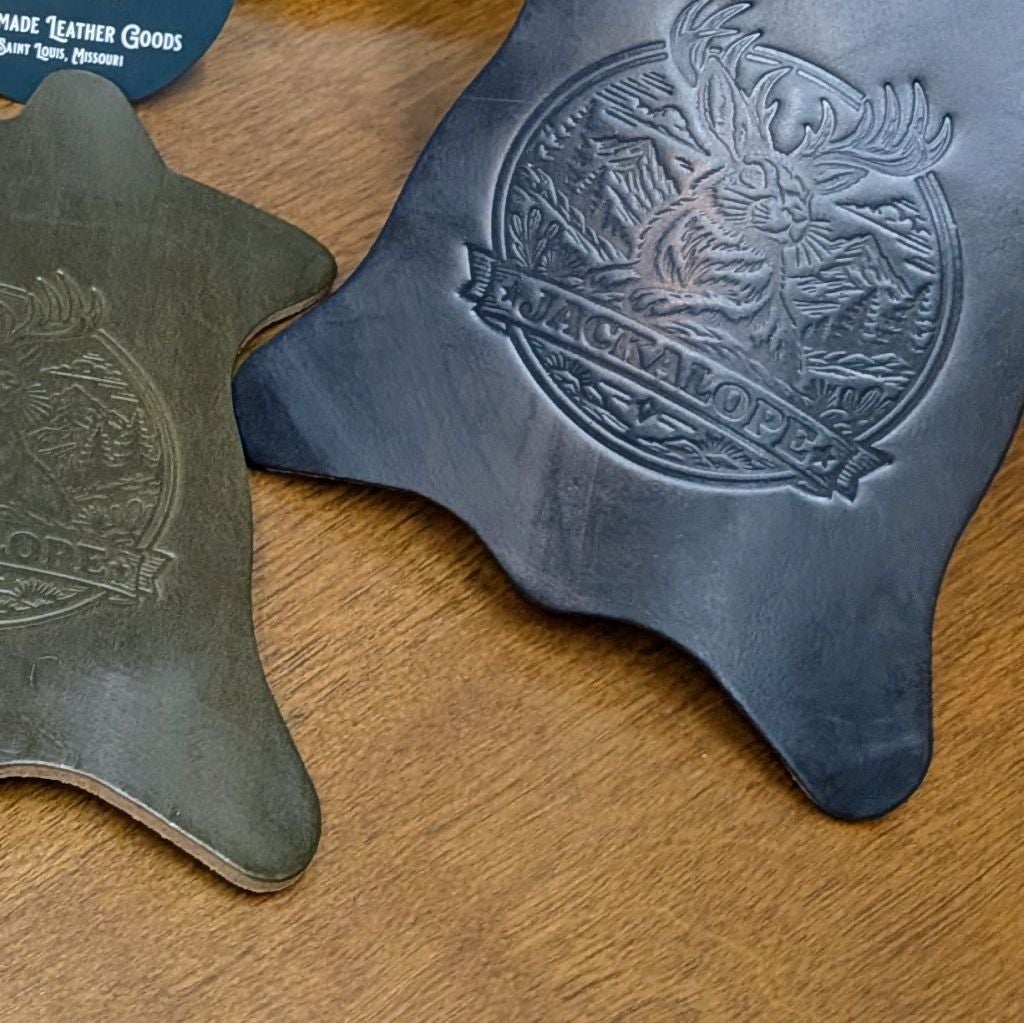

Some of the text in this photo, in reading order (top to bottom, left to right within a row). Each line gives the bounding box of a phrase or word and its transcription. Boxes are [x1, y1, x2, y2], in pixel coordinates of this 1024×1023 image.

[45, 15, 116, 43] LEATHER
[120, 23, 183, 52] GOODS
[33, 42, 68, 62] LOUIS,
[71, 47, 125, 68] MISSOURI
[519, 287, 818, 454] JACKALOPE
